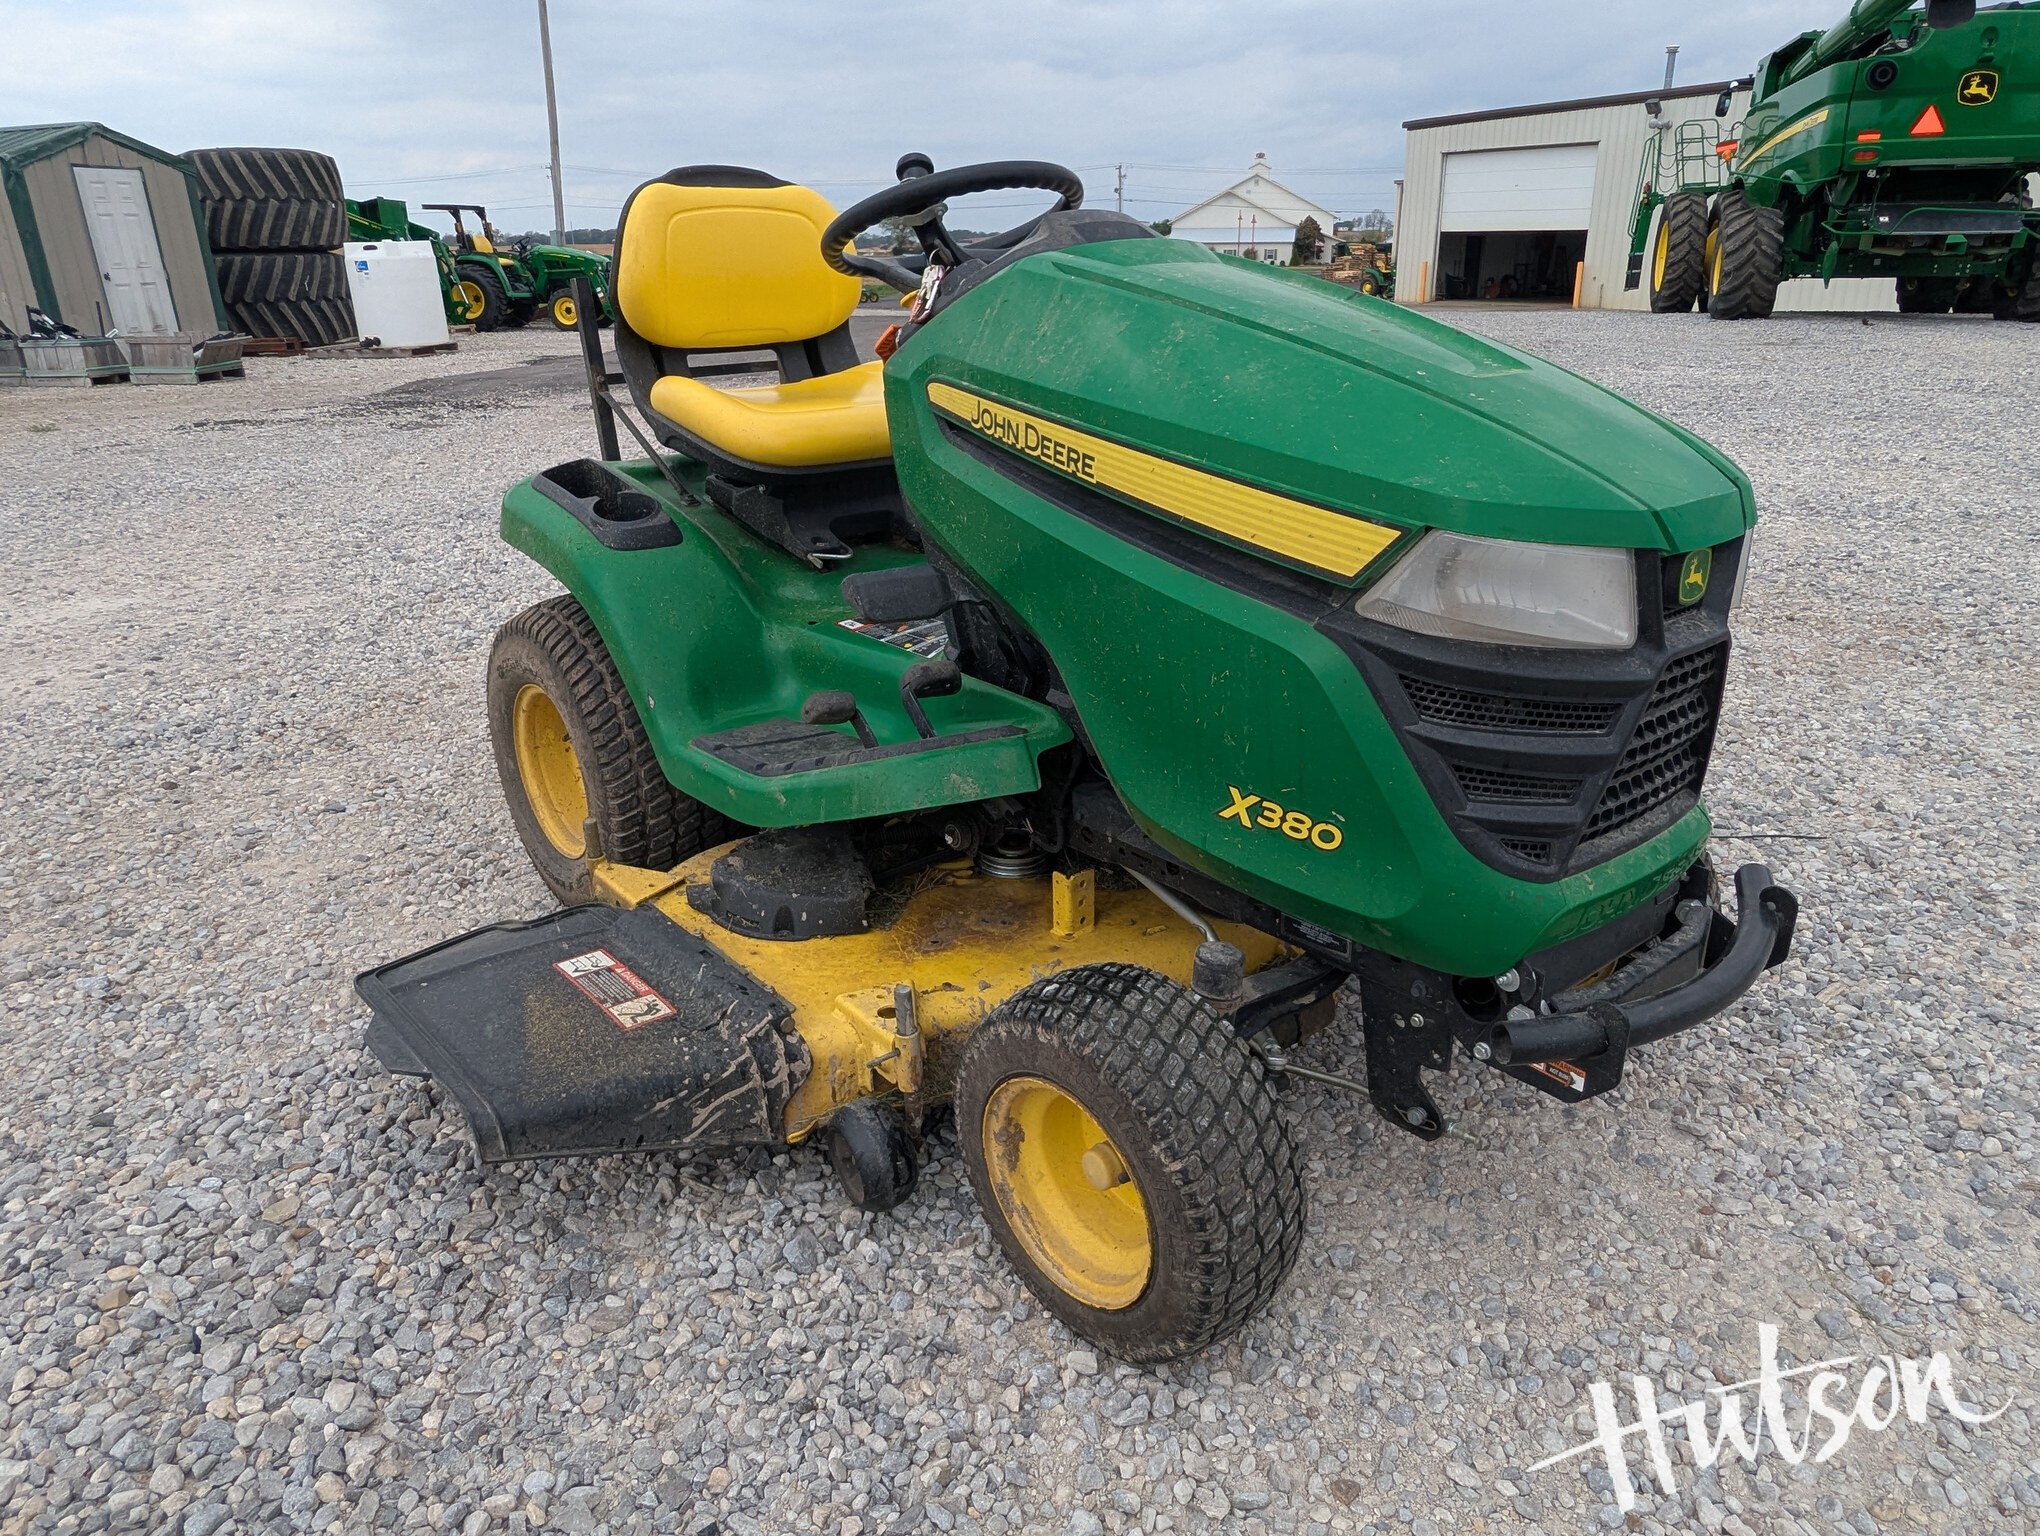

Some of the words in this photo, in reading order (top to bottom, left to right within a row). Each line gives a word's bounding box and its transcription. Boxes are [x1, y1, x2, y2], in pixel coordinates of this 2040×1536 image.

[970, 399, 1020, 446] JOHN
[1024, 421, 1096, 480] DEERE
[1217, 783, 1344, 851] X380
